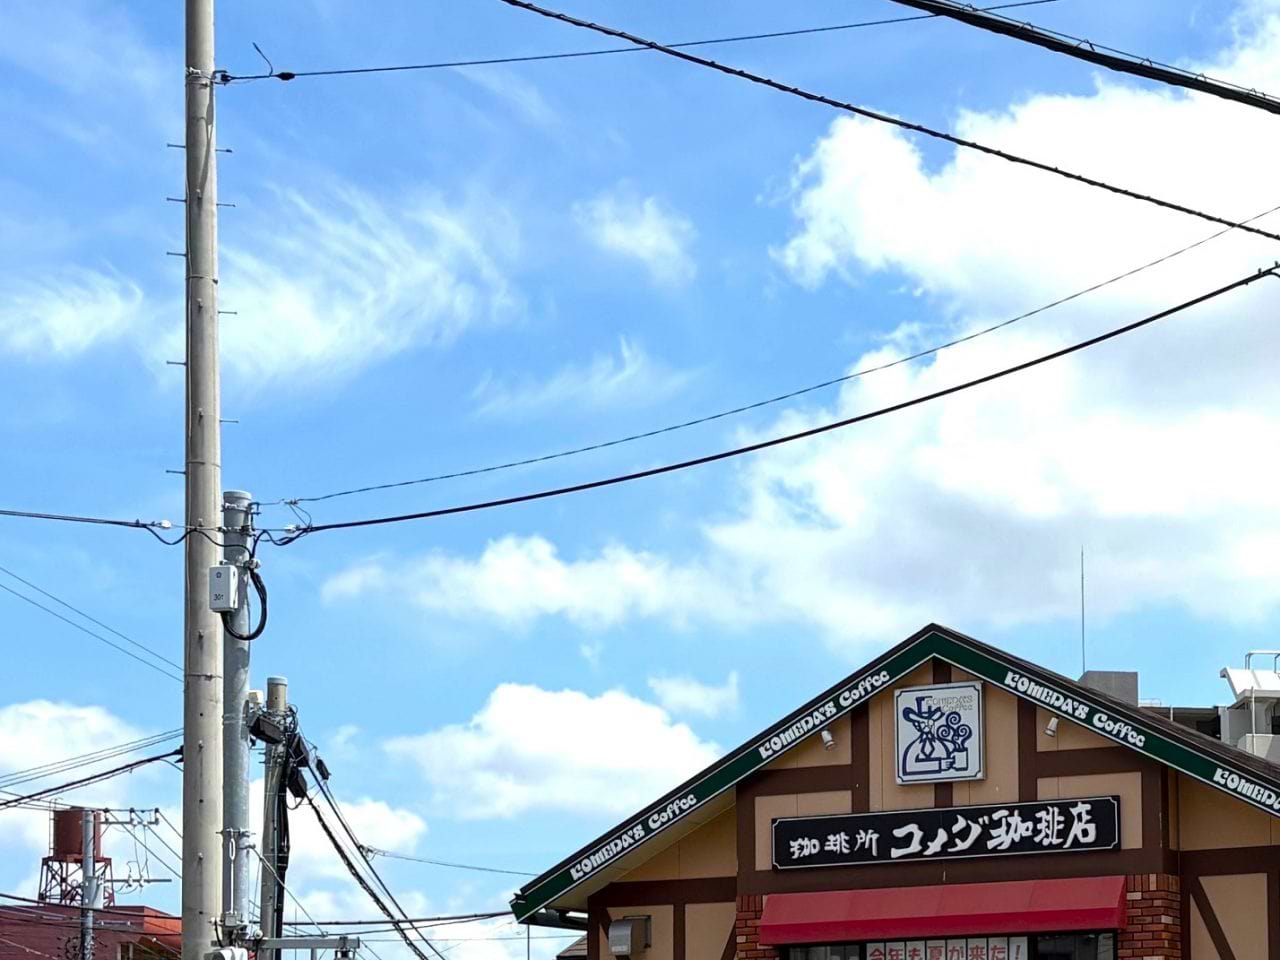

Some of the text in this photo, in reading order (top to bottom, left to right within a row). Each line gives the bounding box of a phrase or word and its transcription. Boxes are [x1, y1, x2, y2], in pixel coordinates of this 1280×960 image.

[758, 670, 890, 760] KOMEDA'S Coffee
[1003, 671, 1146, 748] KOMEDA'S Coffee
[569, 794, 697, 881] KOMEDA'S Coffee
[789, 801, 1097, 859] 珈琲所 コメダ珈琲店
